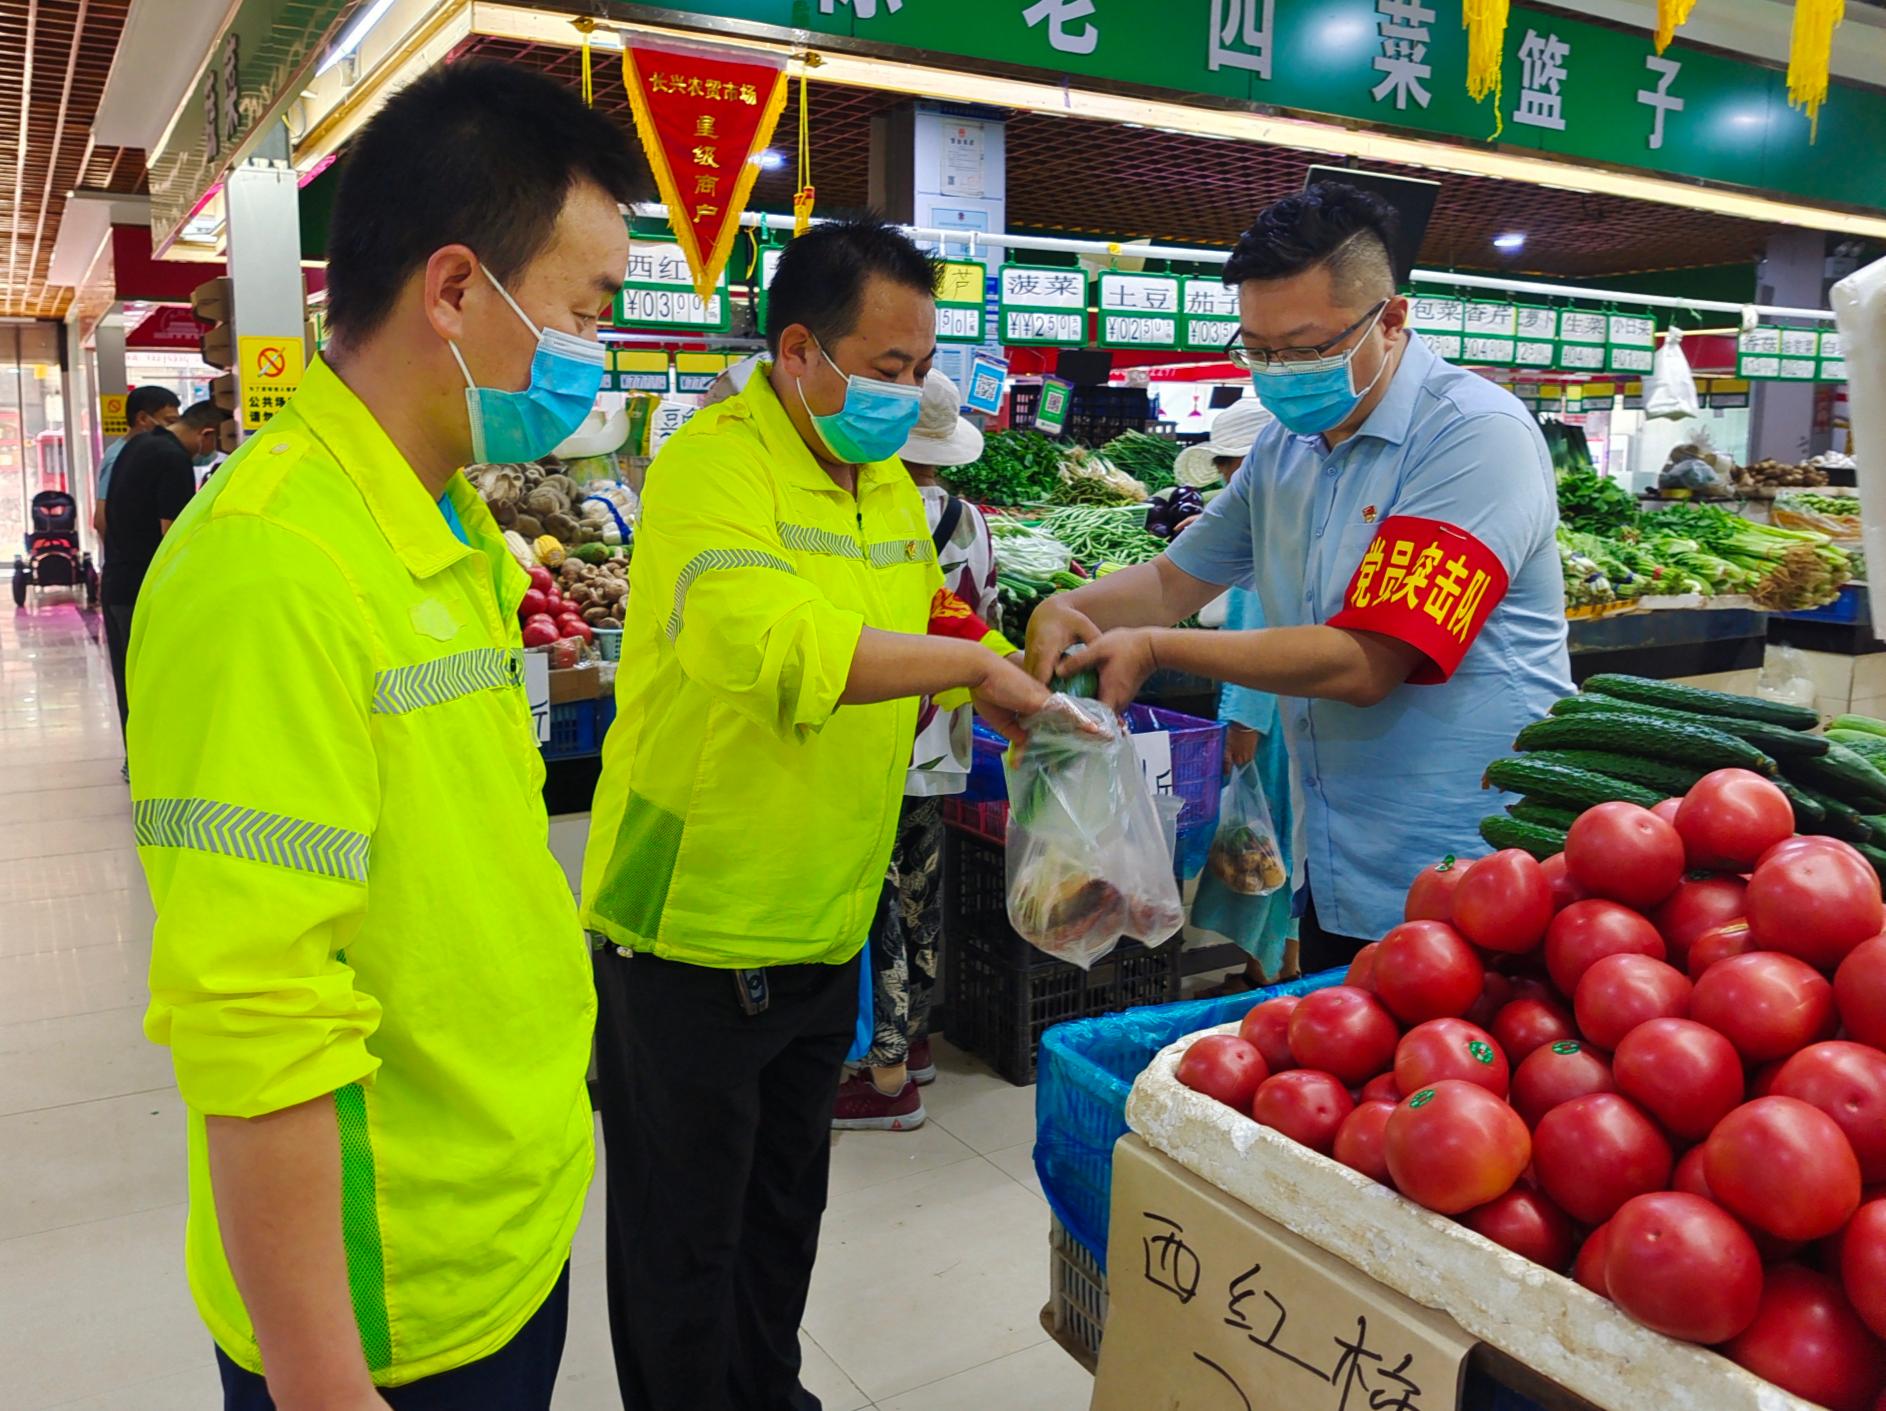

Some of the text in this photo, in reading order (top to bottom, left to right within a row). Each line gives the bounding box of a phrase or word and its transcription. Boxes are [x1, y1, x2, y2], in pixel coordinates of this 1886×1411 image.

[649, 71, 757, 106] 长兴农贸市场
[627, 254, 693, 281] 西红
[1008, 275, 1079, 296] 菠菜
[1106, 285, 1171, 311] 土豆
[1187, 291, 1239, 315] 茄子
[1411, 300, 1461, 321] 包菜
[1465, 303, 1511, 324] 香芹
[1566, 315, 1602, 335] 生菜
[1351, 536, 1491, 644] 党员突击队
